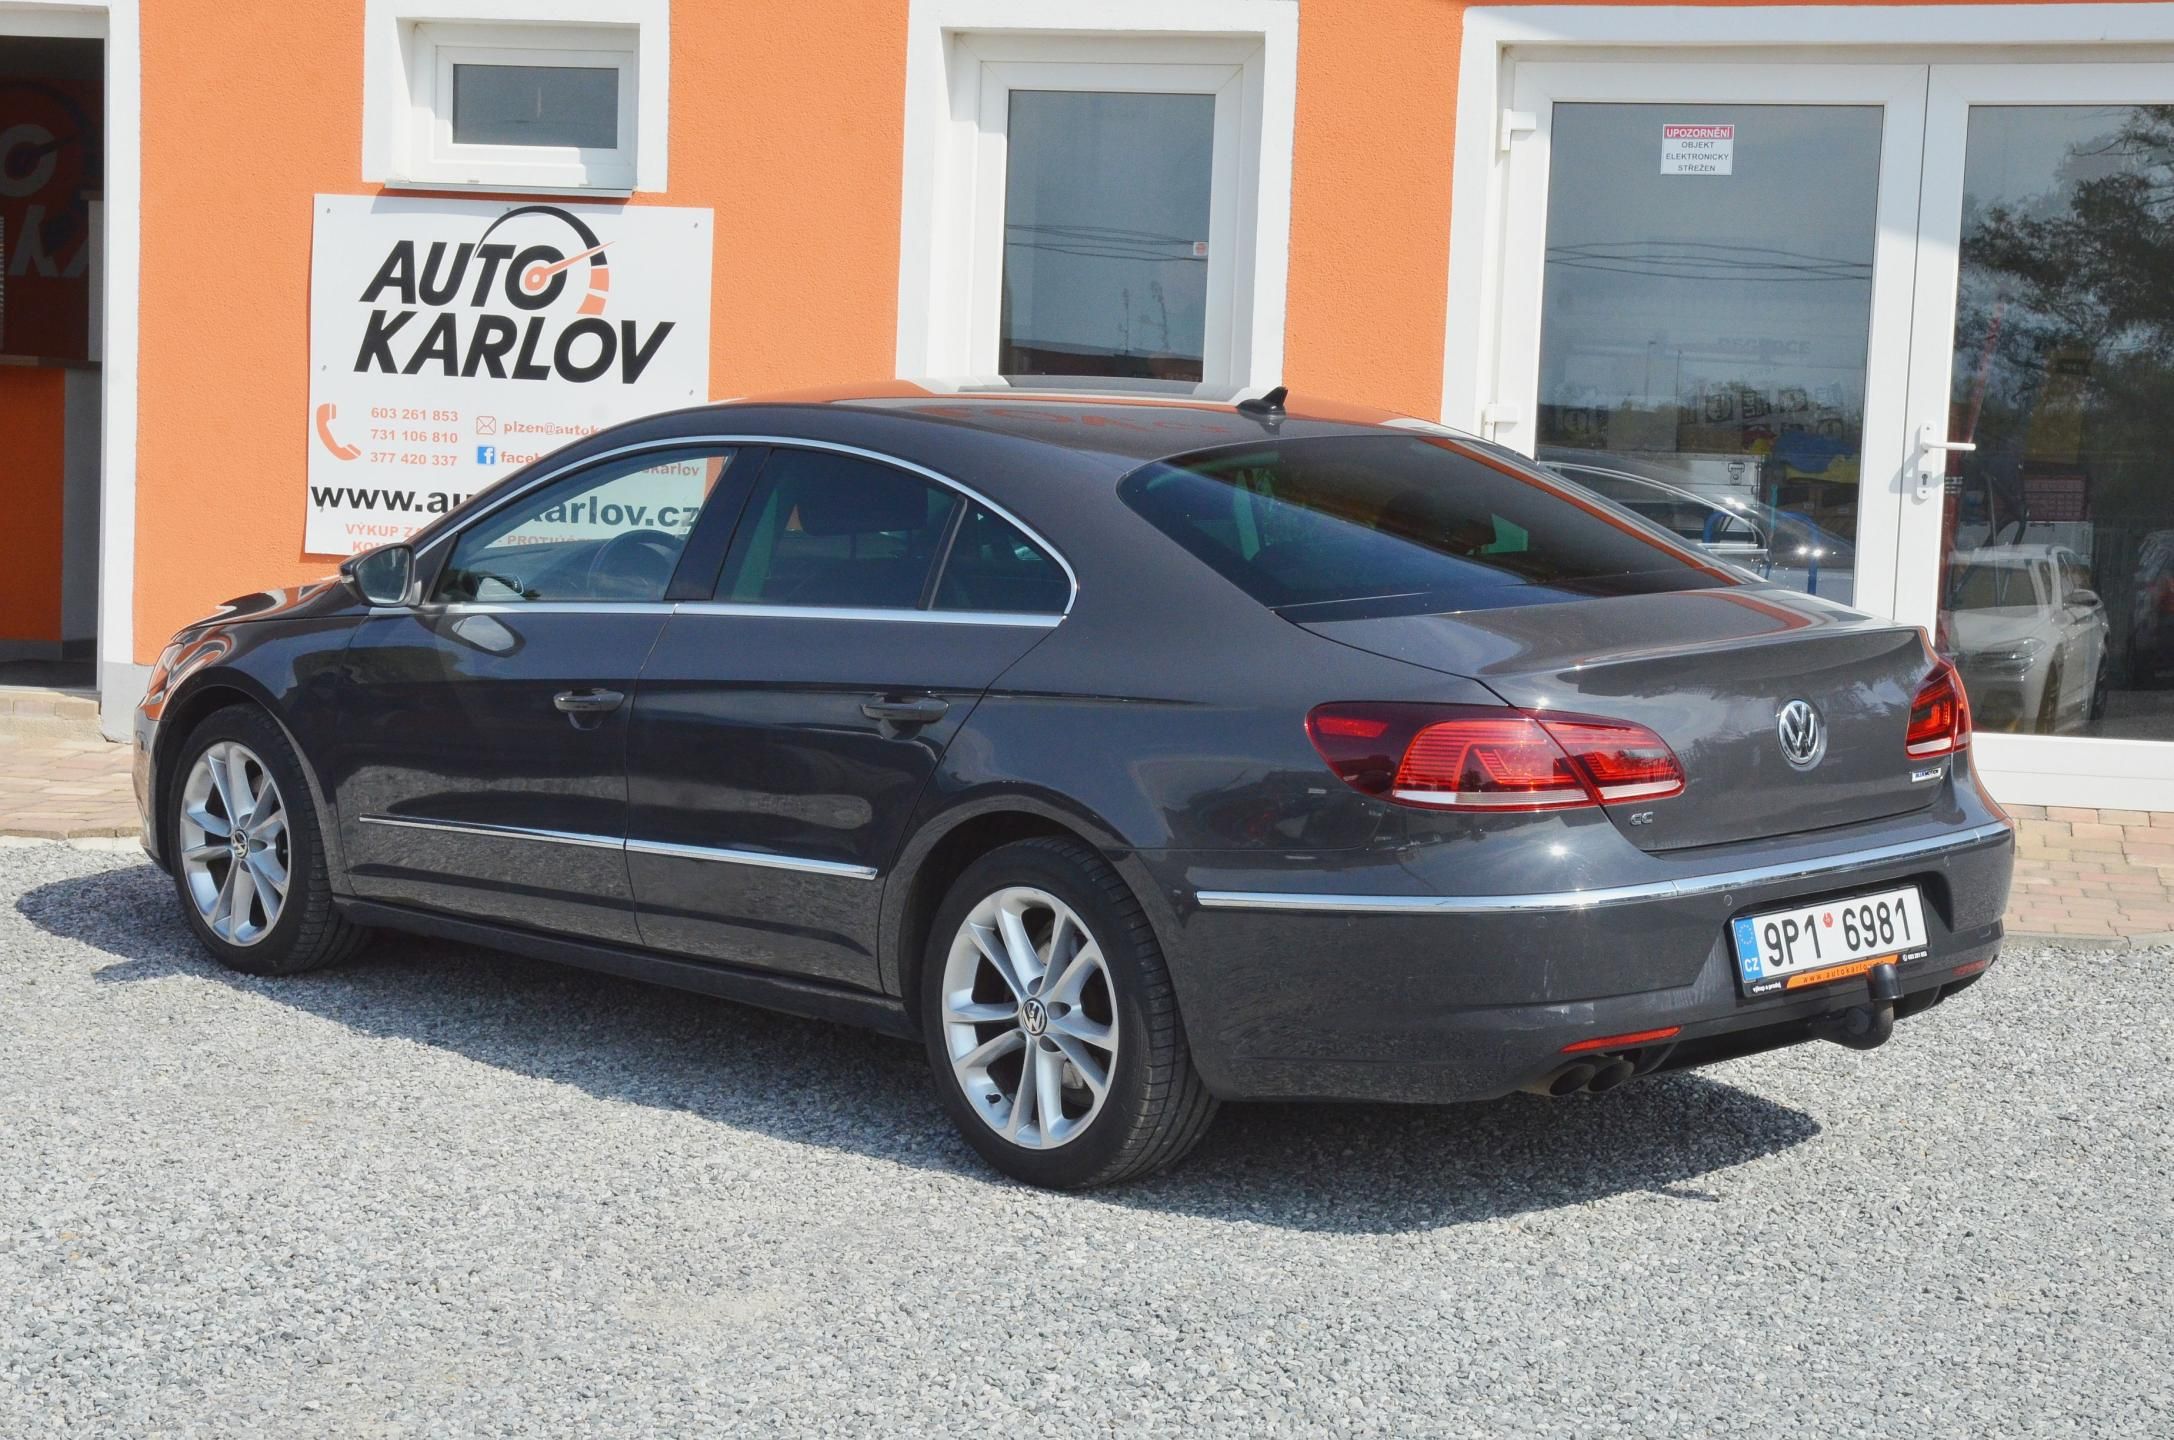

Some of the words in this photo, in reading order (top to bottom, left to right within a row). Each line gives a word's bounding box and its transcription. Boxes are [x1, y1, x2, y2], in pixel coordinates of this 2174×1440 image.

[1666, 126, 1730, 138] UPOZORNĚNÍ
[1681, 141, 1714, 149] OBJEKT
[1665, 152, 1729, 160] ELEKTRONICKY
[1678, 164, 1716, 172] STŘEŽEN
[358, 239, 568, 311] AUTO
[353, 309, 677, 384] KARLOV
[371, 407, 397, 419] 603
[402, 408, 426, 421] 261
[432, 410, 458, 422] 853
[370, 428, 396, 440] 731
[401, 430, 428, 442] 106
[432, 431, 458, 443] 810
[503, 420, 605, 436] plzen@autok
[370, 452, 396, 463] 377
[400, 453, 427, 465] 420
[431, 454, 458, 466] 337
[1630, 811, 1654, 826] CC
[1763, 914, 1822, 967] 9P1
[1842, 897, 1911, 951] 6981
[1744, 957, 1760, 972] CZ
